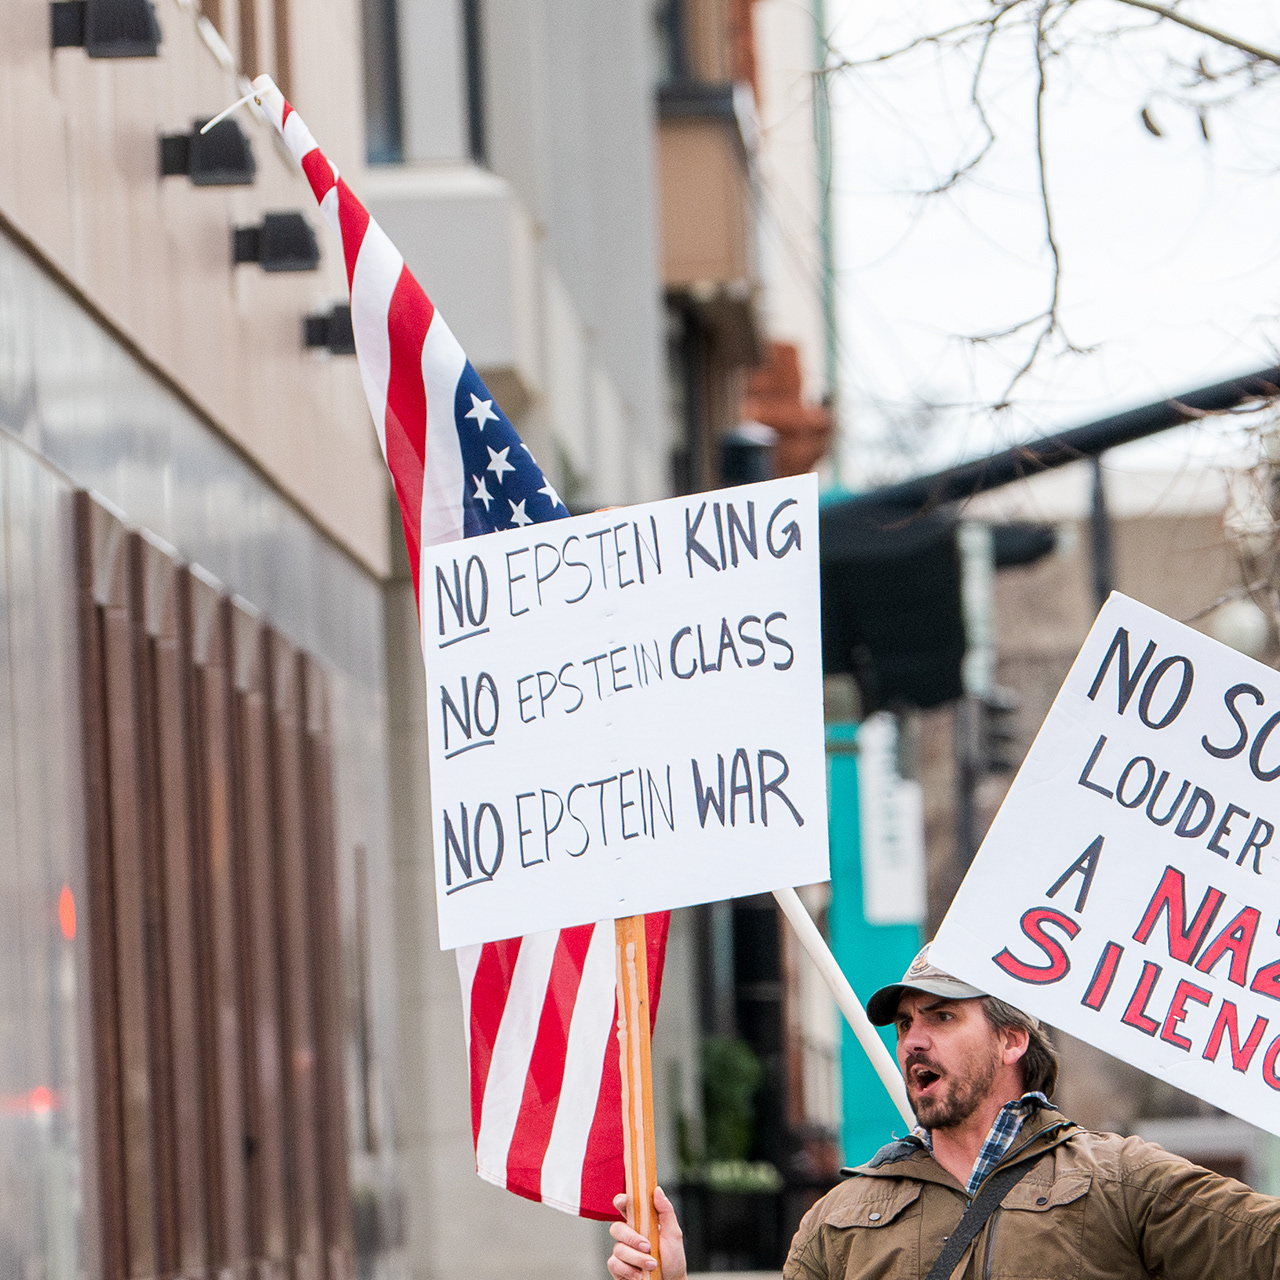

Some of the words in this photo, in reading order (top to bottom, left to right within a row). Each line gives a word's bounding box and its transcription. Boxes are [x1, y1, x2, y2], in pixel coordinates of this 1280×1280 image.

[435, 555, 489, 636] NO
[685, 498, 802, 579] KING
[439, 671, 500, 750] NO
[516, 638, 663, 724] EPSTEIN
[669, 611, 795, 680] CLASS
[1086, 626, 1195, 730] NO
[442, 801, 505, 886] NO
[515, 764, 675, 869] EPSTEIN
[690, 747, 805, 829] WAR
[1077, 734, 1275, 875] LOUDER
[1045, 834, 1105, 914] A
